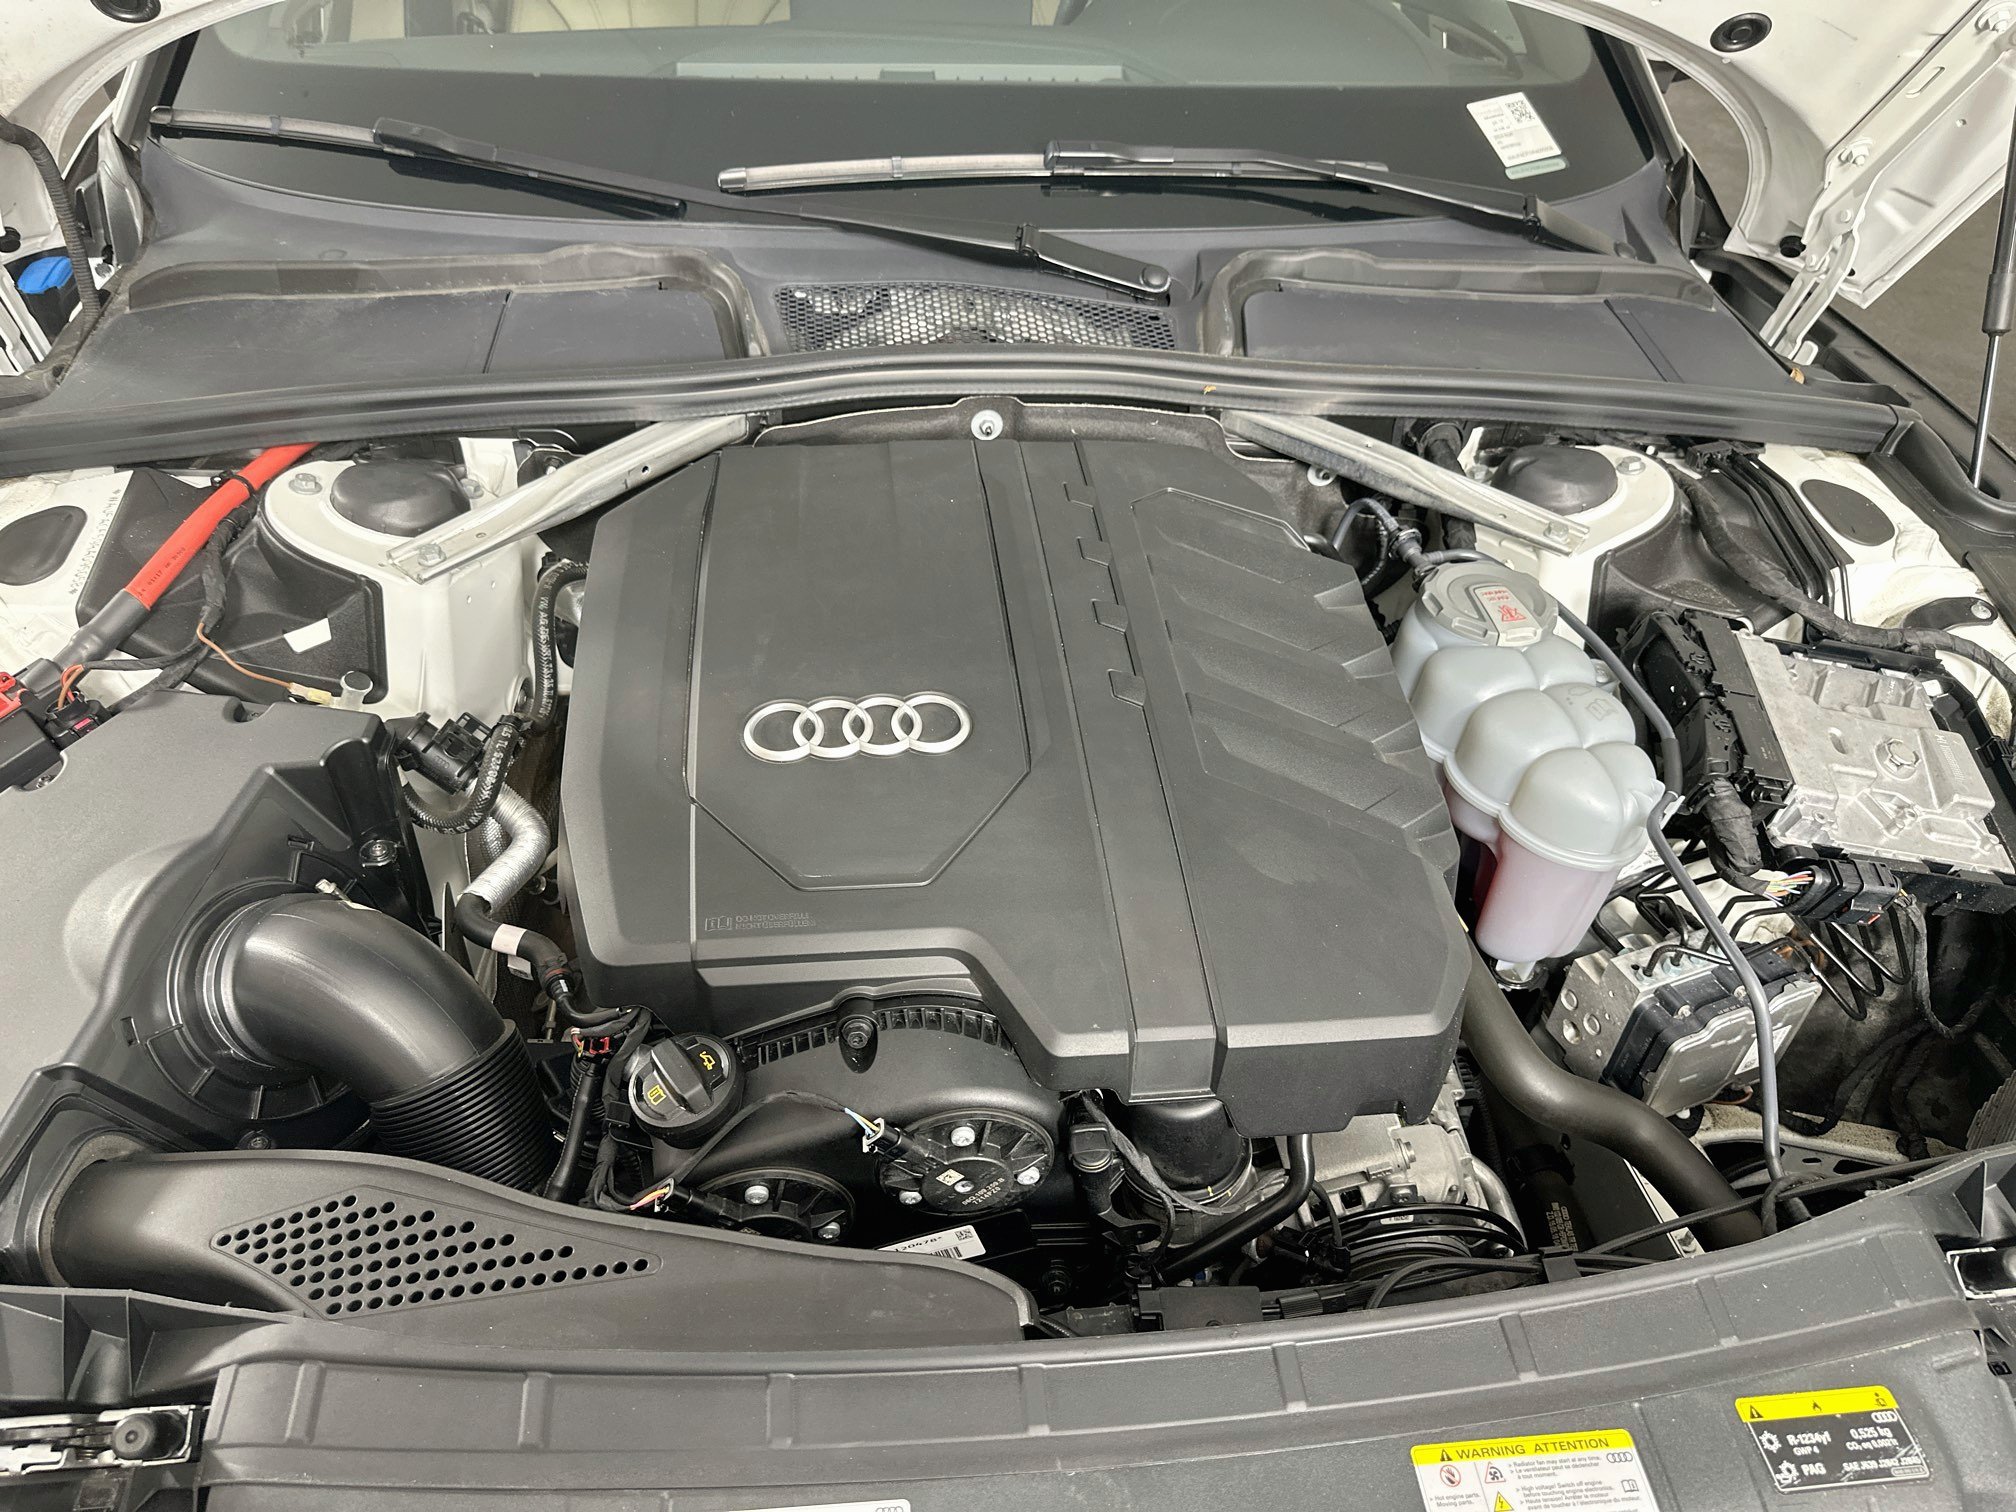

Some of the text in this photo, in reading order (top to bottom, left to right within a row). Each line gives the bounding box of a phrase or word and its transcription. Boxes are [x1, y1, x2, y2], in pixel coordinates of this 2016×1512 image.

[1786, 1430, 1832, 1446] R-1234yf
[1849, 1426, 1894, 1440] 0,525 kg
[1456, 1438, 1610, 1460] WARNING ATTENTION
[1792, 1446, 1812, 1456] GWP
[1800, 1462, 1826, 1476] PAG
[1842, 1462, 1861, 1472] SAE
[1446, 1493, 1465, 1502] engine
[1436, 1500, 1458, 1508] Moving
